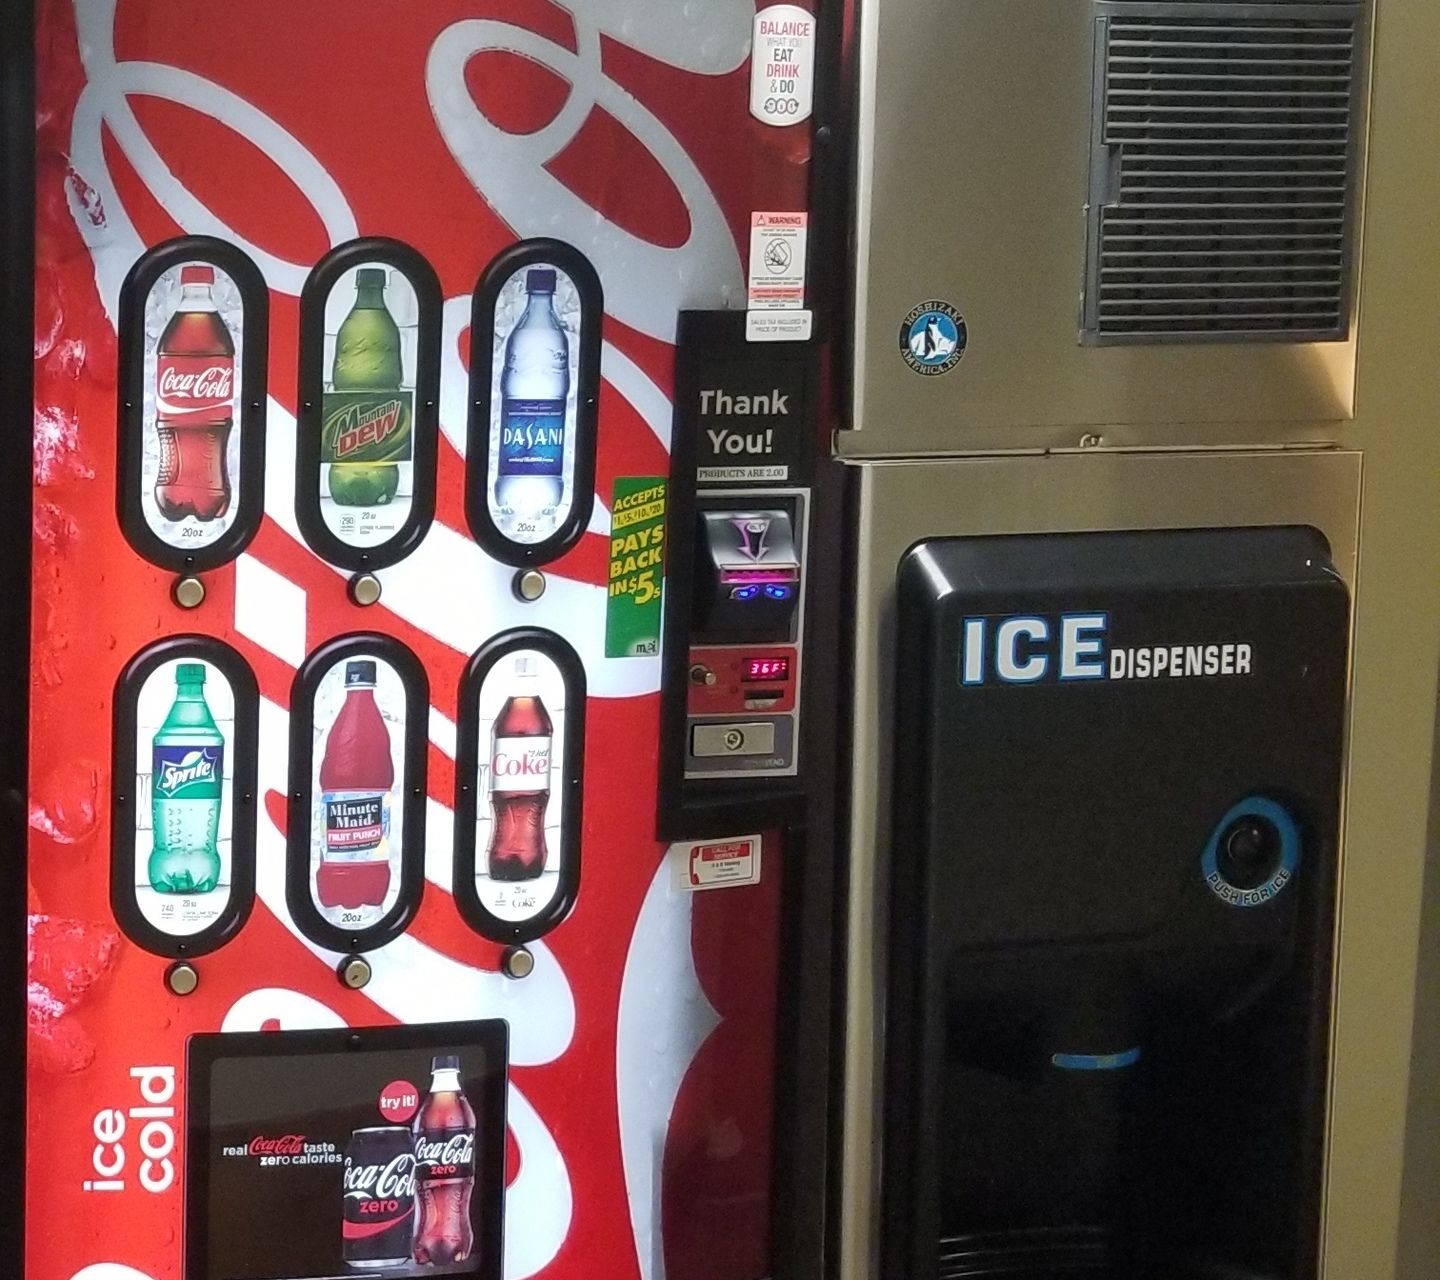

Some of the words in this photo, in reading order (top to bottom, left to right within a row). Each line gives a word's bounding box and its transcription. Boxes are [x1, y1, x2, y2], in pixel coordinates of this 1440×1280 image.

[760, 20, 810, 36] BALANCE
[773, 48, 794, 62] EAT
[766, 64, 800, 78] DRINK
[770, 79, 777, 93] &
[780, 80, 794, 93] DO
[904, 301, 963, 326] HOSHIZAKI
[160, 366, 232, 398] Coca-Cola
[700, 389, 789, 415] Thank
[333, 400, 397, 448] Mountain
[504, 423, 563, 450] DASANI
[707, 429, 773, 454] You!
[699, 469, 745, 479] PRODUCTS
[747, 469, 764, 478] ARE
[766, 468, 784, 477] 2.00
[613, 485, 665, 512] ACCEPTS
[611, 524, 664, 558] PAYS
[610, 545, 663, 579] BACK
[962, 613, 1106, 684] ICE
[1110, 643, 1252, 679] DISPENSER
[163, 758, 211, 789] Sprite
[492, 752, 548, 776] Coke
[330, 803, 379, 817] Minute
[328, 832, 352, 842] FRUIT
[352, 828, 381, 840] PUNCH
[1207, 871, 1238, 902] PUSH
[1244, 888, 1269, 904] FOR
[1272, 868, 1290, 892] ICE
[161, 904, 174, 912] 240
[380, 1096, 400, 1109] try
[402, 1095, 416, 1107] it!
[129, 1065, 175, 1193] cold
[83, 1108, 126, 1191] ice
[223, 1144, 248, 1156] real
[304, 1142, 335, 1153] taste
[260, 1155, 290, 1166] zero
[292, 1152, 342, 1165] calories
[430, 1165, 457, 1175] zero
[359, 1199, 399, 1213] zero
